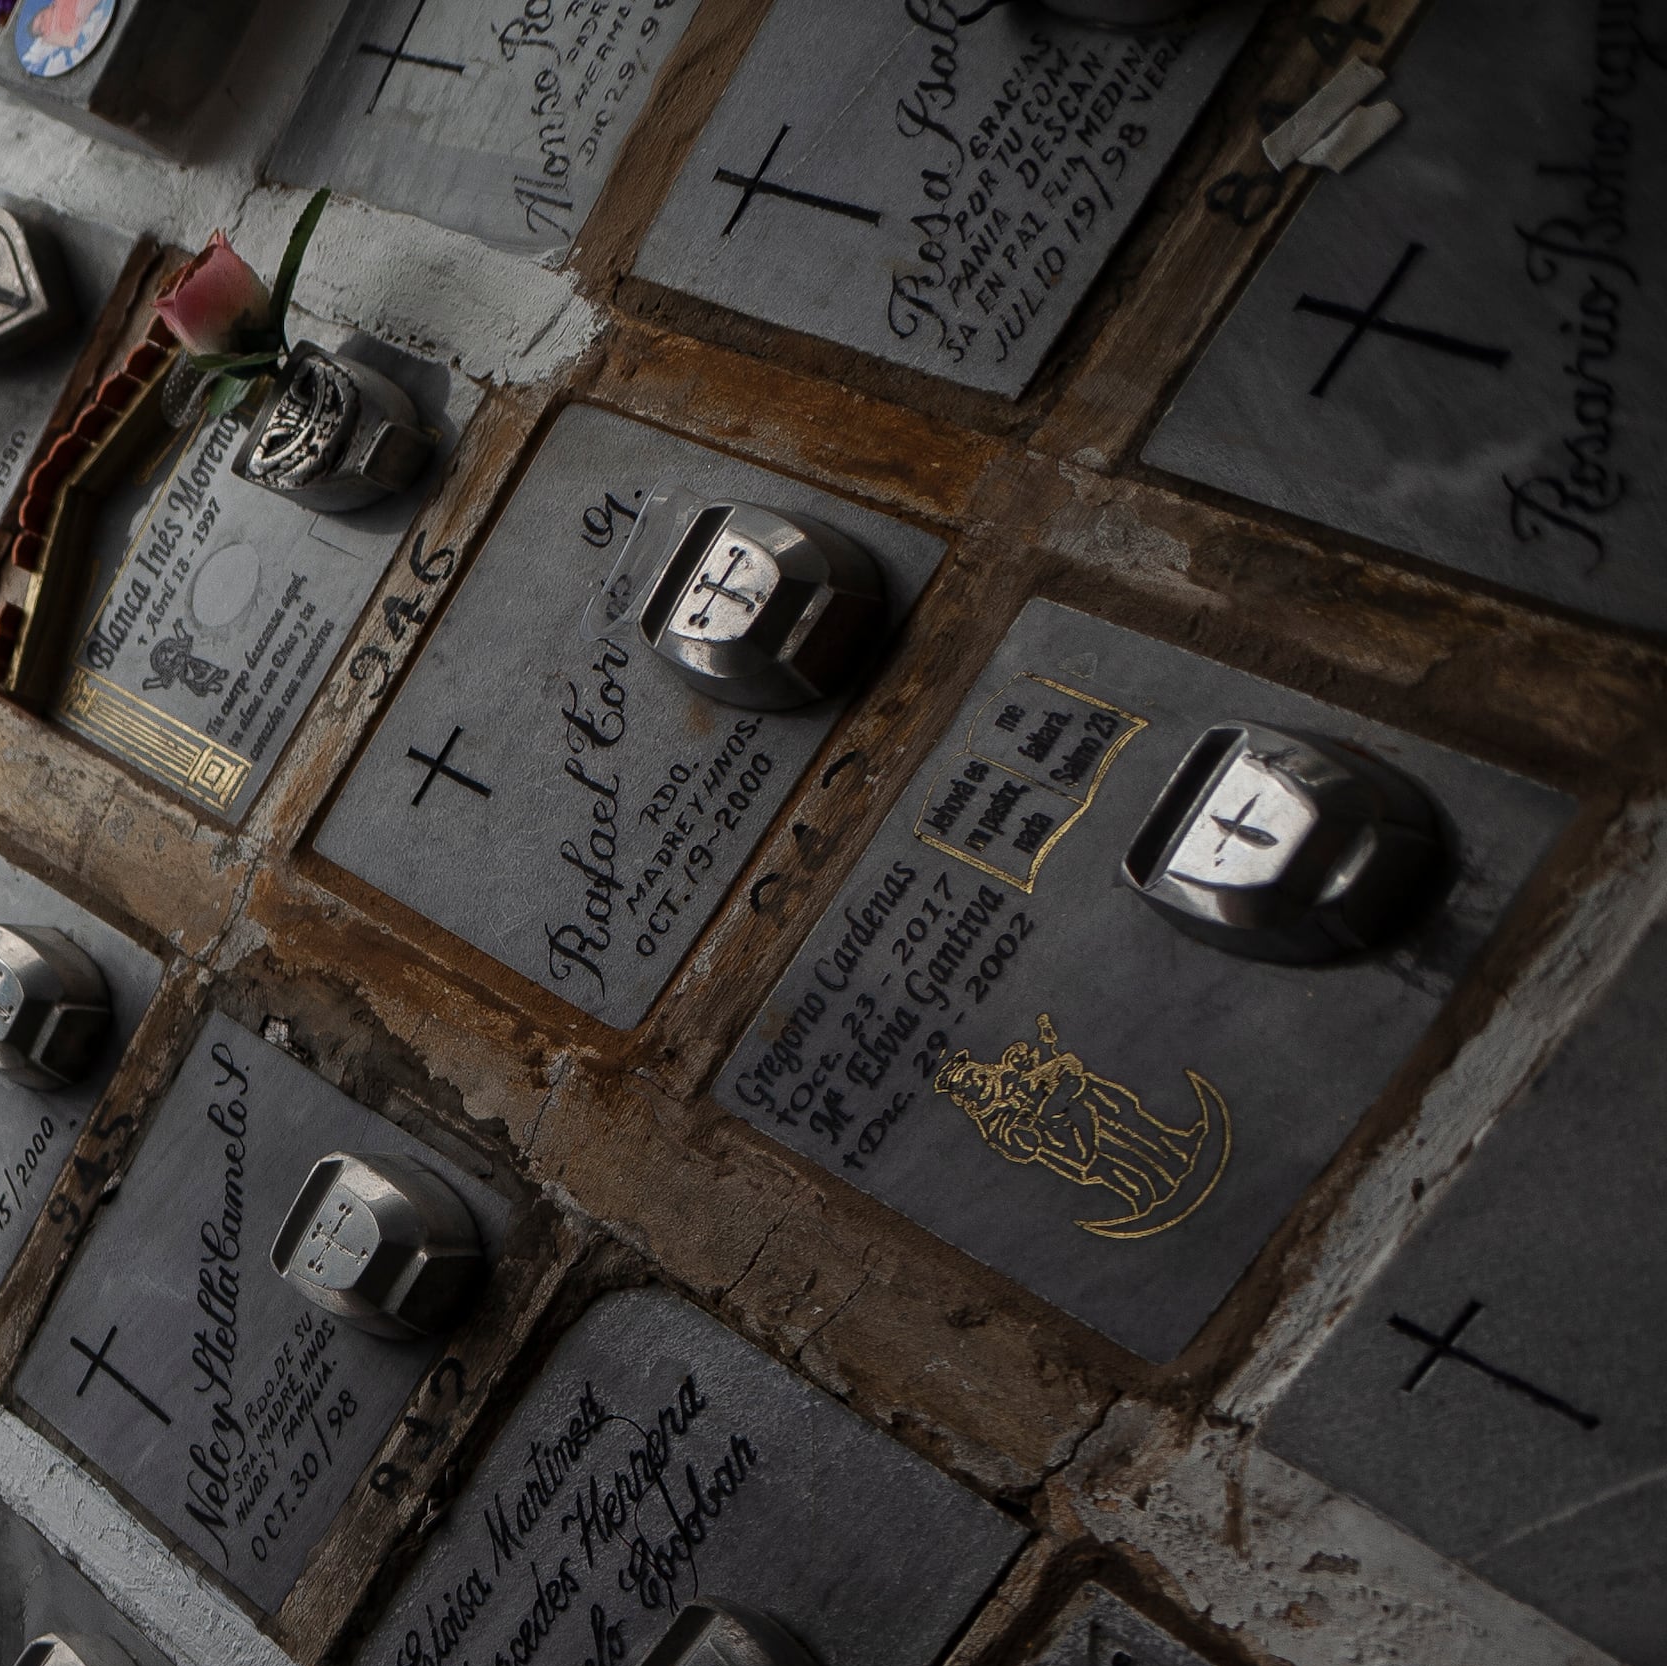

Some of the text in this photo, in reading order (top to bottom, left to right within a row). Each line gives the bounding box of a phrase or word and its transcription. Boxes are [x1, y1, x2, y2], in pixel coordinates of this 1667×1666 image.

[953, 42, 1077, 243] POR TU COM-
[969, 30, 1055, 160] GRACIAS
[1015, 51, 1104, 190] DESCAN-
[887, 169, 952, 347] Rosa
[945, 324, 978, 363] SA
[975, 272, 1006, 315] EN
[1002, 211, 1048, 270] PAZ
[1075, 29, 1165, 147] MEDINA
[995, 123, 1148, 364] JULIO 19/98
[1501, 277, 1628, 562] Rosario
[79, 404, 245, 669] Blanca Inés Moreno
[147, 497, 221, 636] Abril 18 1997
[221, 671, 250, 716] cuerpo
[244, 608, 286, 670] descansa
[995, 704, 1026, 732] me
[639, 762, 700, 825] RDO.
[923, 758, 991, 836] Jehová es
[1050, 711, 1120, 783] Salmo 23
[544, 764, 624, 994] Rafael
[1013, 812, 1054, 854] nada
[636, 888, 691, 957] OCT.
[735, 861, 917, 1113] Gregorio Cardenas
[841, 872, 953, 1039] 23 2017
[845, 1006, 920, 1090] Elvia
[905, 884, 1005, 1012] Gantiva
[913, 912, 1035, 1080] 29 2002
[201, 1099, 247, 1262] Camelo
[192, 1268, 240, 1397] Stella
[243, 1310, 315, 1428] RDO. DE SU
[185, 1402, 245, 1560] Nelcy
[231, 1449, 259, 1492] SRA.
[236, 1464, 270, 1522] HIJOS
[283, 1361, 333, 1447] FAMILIA.
[251, 1383, 363, 1563] OCT. 30/98
[484, 1381, 608, 1575] Martinez
[561, 1374, 707, 1568] Herrera
